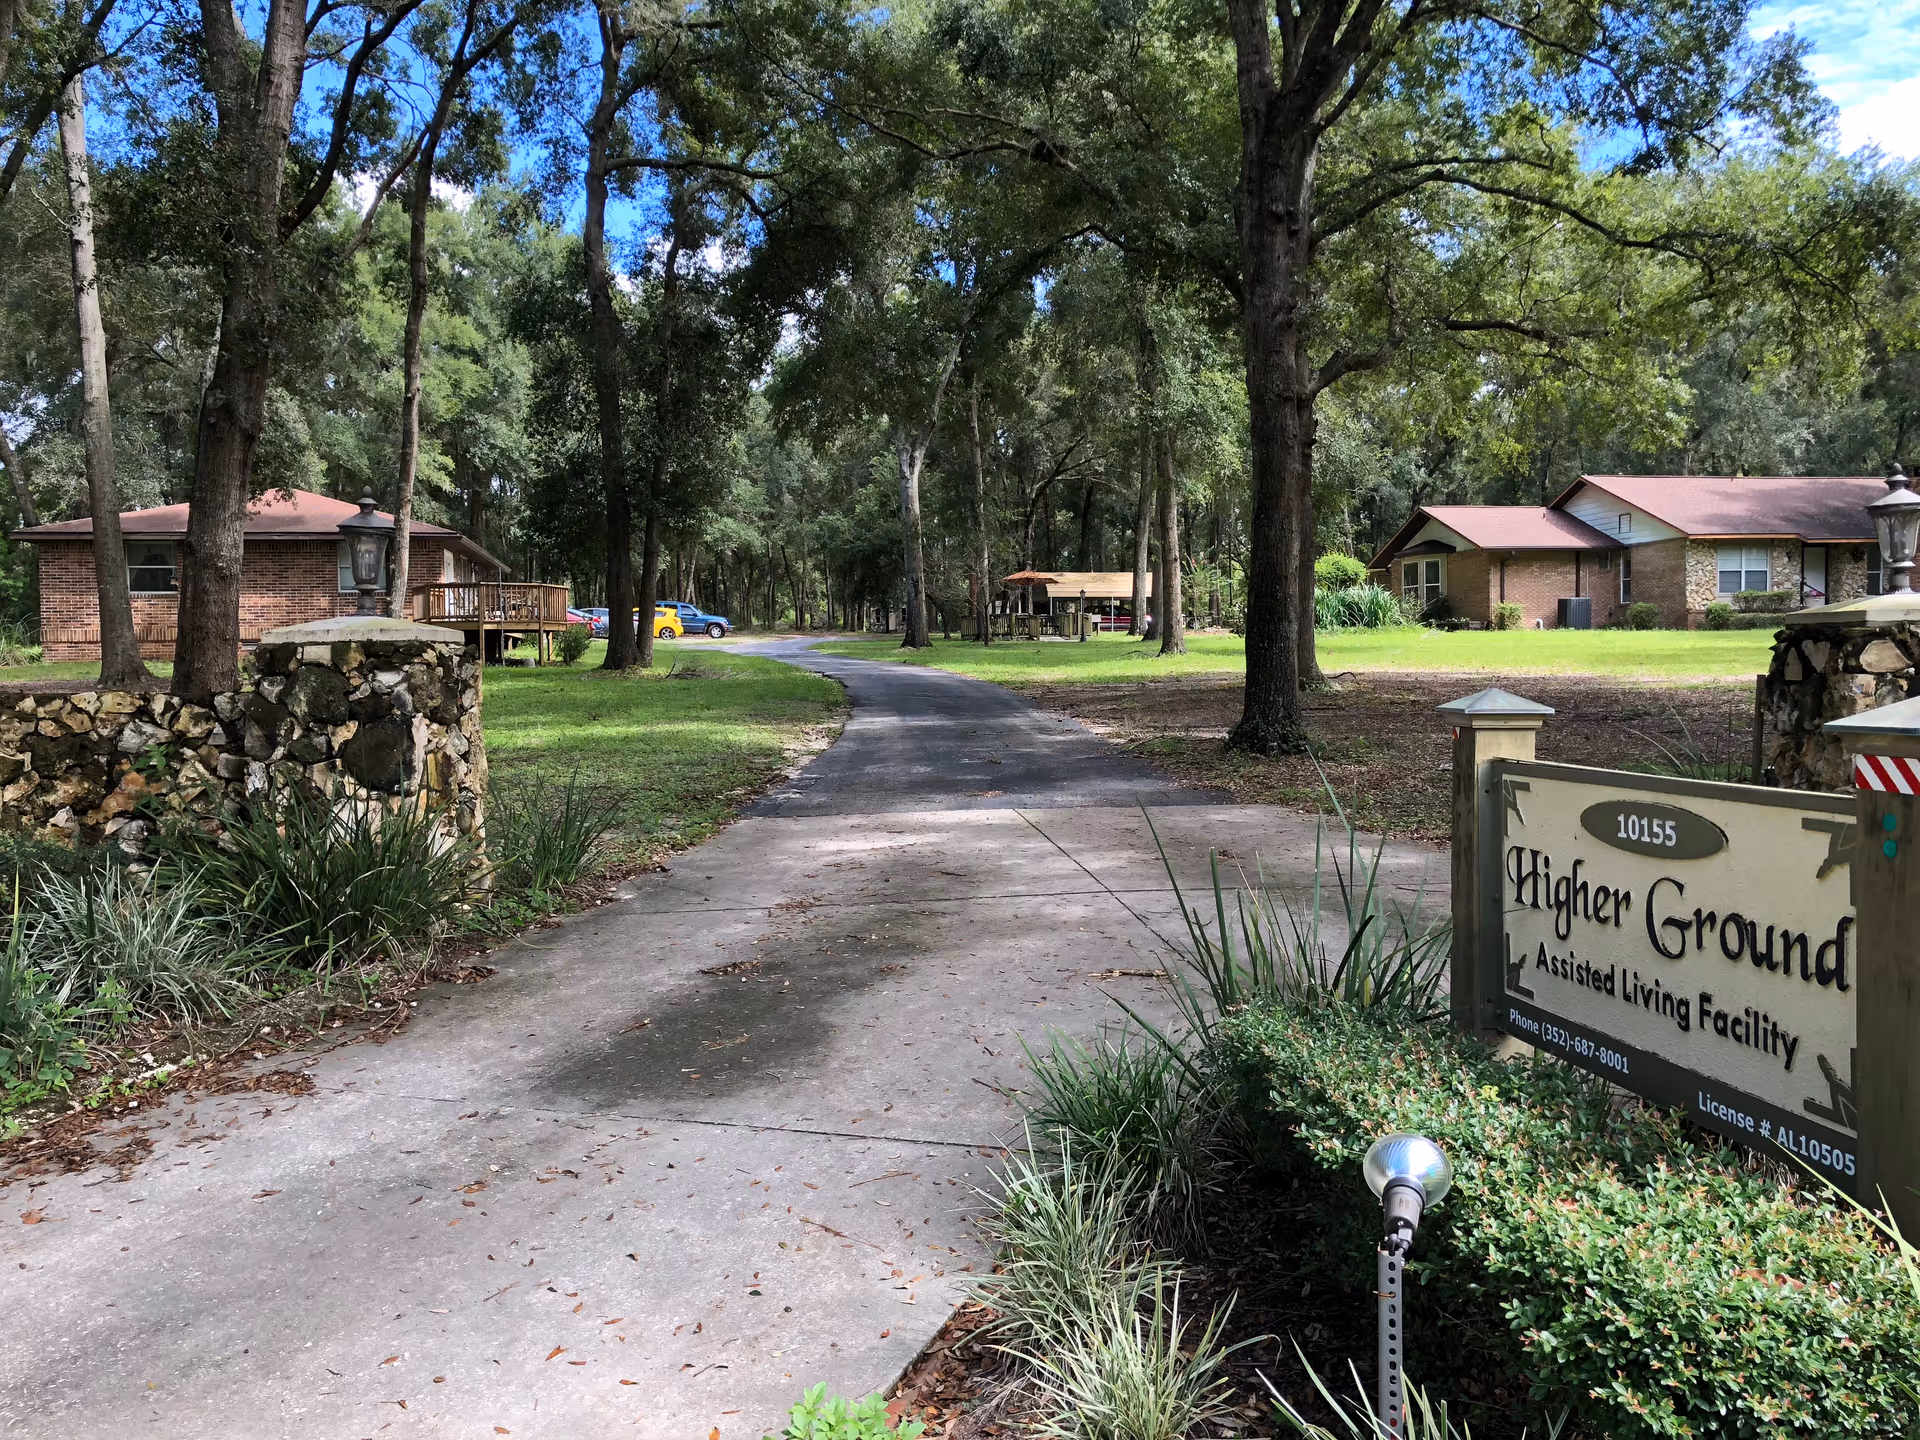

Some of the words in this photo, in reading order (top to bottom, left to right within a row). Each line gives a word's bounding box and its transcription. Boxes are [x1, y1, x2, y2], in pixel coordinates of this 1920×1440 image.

[1616, 813, 1677, 847] 10155
[1506, 845, 1631, 941] Higher
[1646, 876, 1855, 992] Ground
[1509, 1008, 1540, 1036] Phone
[1541, 1020, 1630, 1075] (352)-687-8001
[1535, 941, 1616, 997] Assisted
[1622, 968, 1691, 1032] Living
[1699, 992, 1799, 1071] Facility
[1698, 1091, 1755, 1133] License
[1759, 1118, 1771, 1138] #
[1777, 1127, 1856, 1177] AL10505
